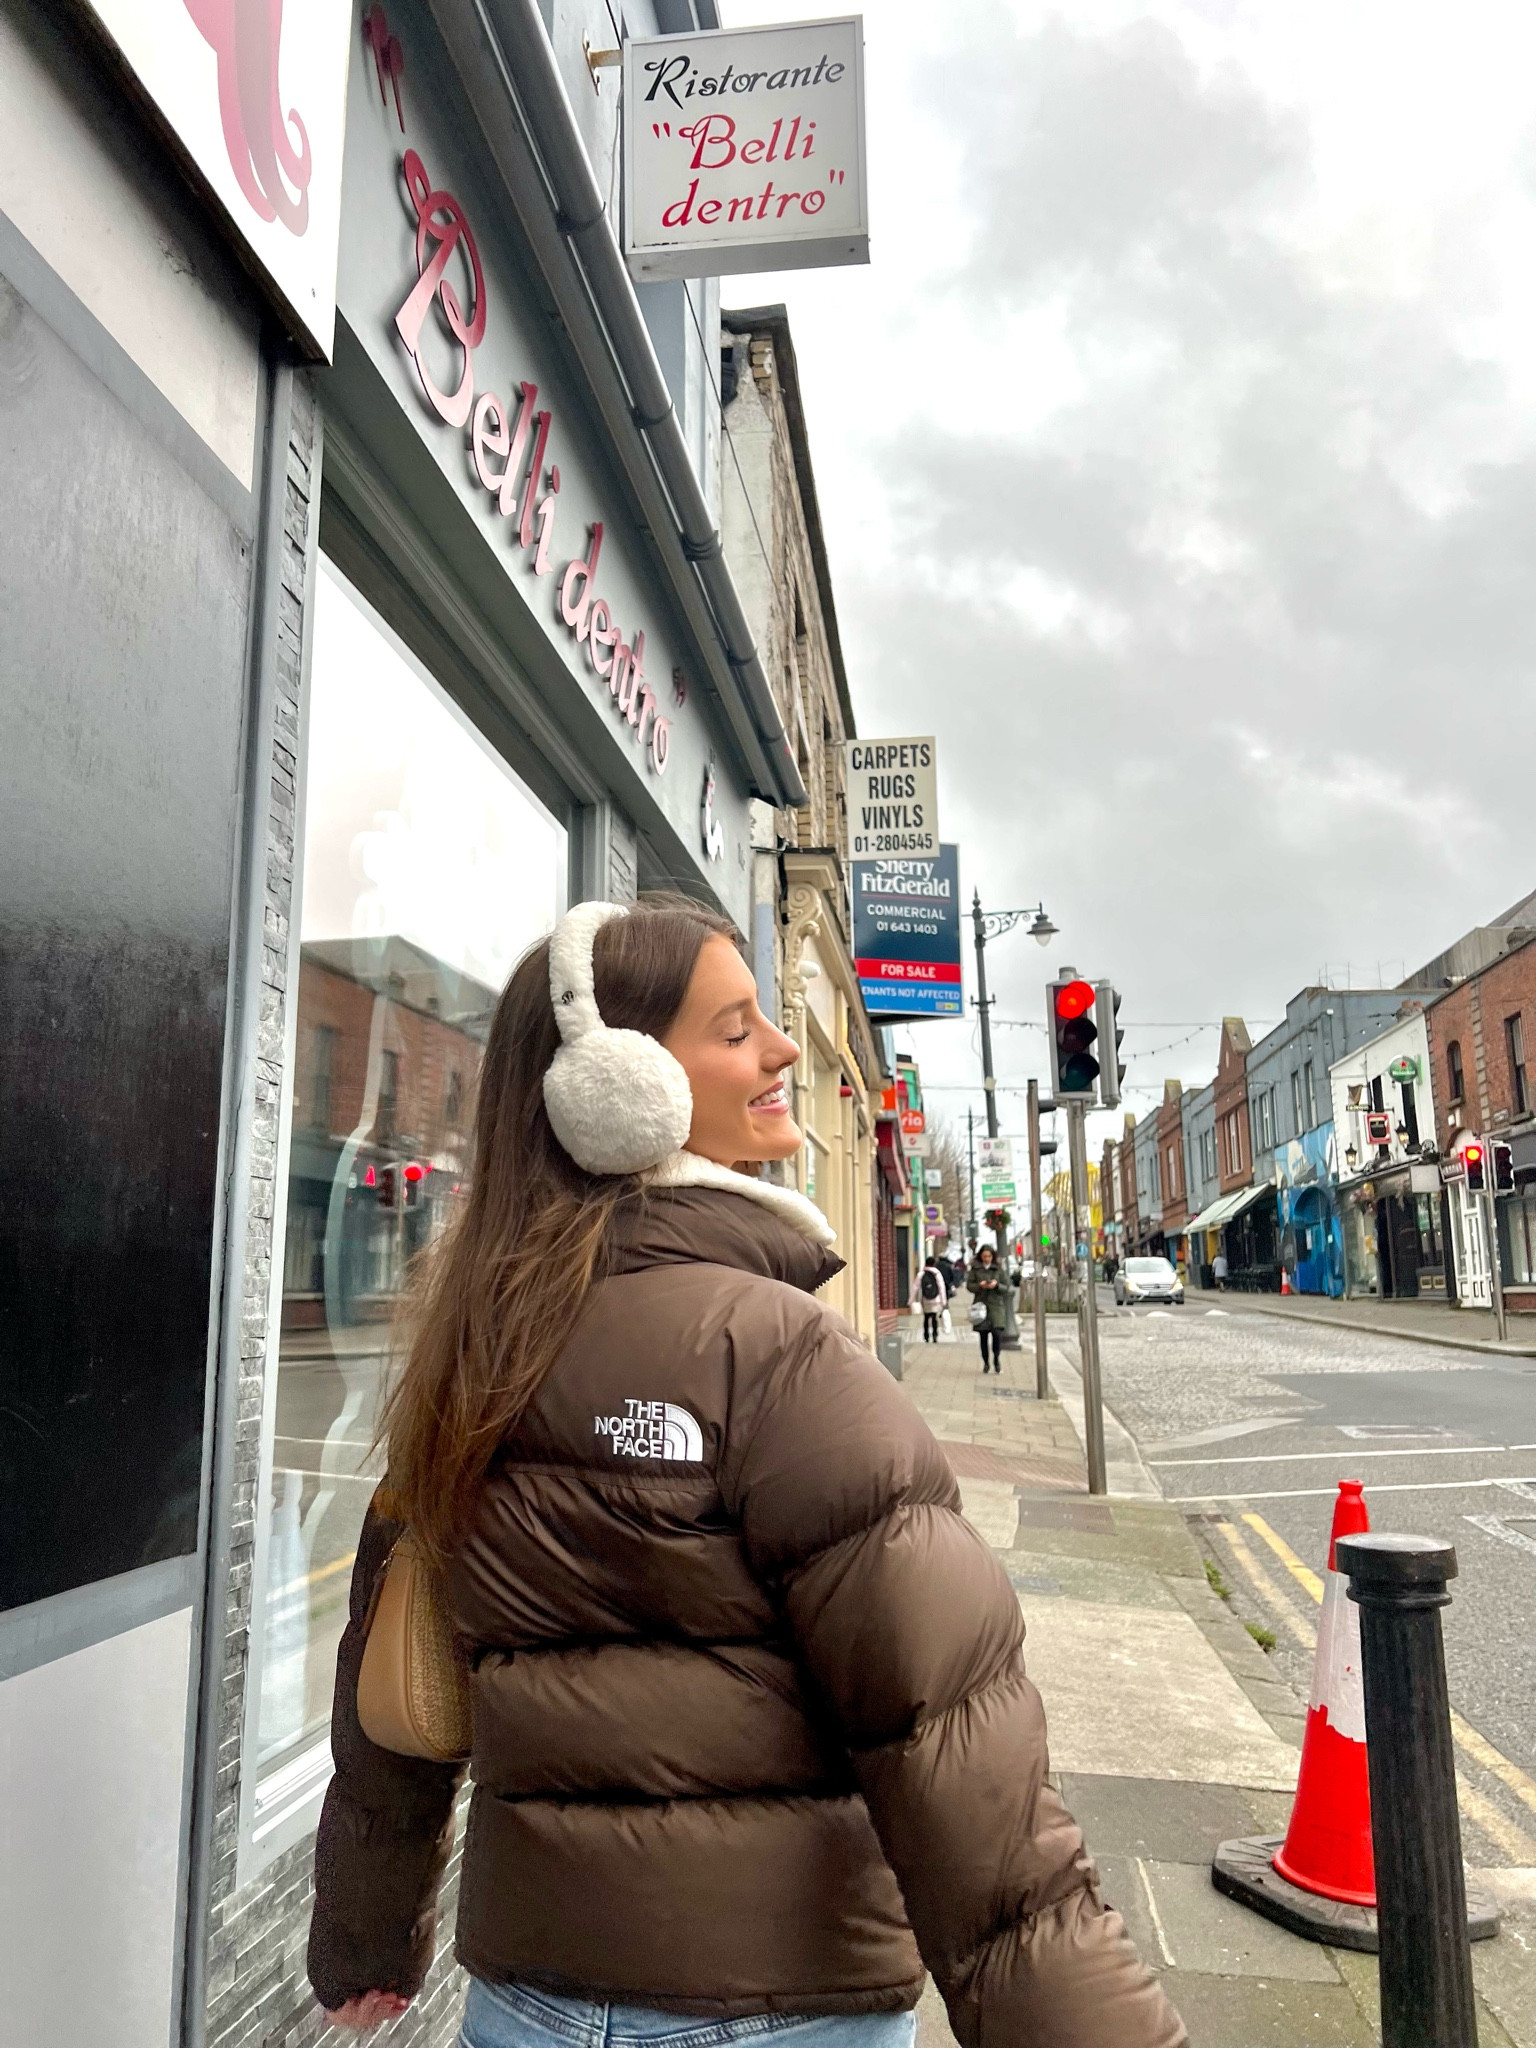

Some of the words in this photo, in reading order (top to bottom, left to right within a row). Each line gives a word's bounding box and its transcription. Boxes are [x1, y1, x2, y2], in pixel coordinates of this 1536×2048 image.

[644, 54, 845, 110] Ristorante
[652, 114, 817, 170] "Belli
[661, 169, 845, 228] dentro"
[852, 743, 931, 771] CARPETS
[868, 774, 916, 800] RUGS
[861, 804, 924, 830] VINYLS
[854, 833, 933, 853] 01-2804545
[861, 872, 950, 898] FitzGerald
[866, 903, 946, 920] COMMERCIAL
[876, 921, 889, 931] 01
[890, 922, 911, 933] 643
[913, 923, 938, 935] 1403
[881, 963, 905, 977] FOR
[906, 965, 936, 979] SALE
[862, 985, 897, 997] ENANTS
[898, 987, 915, 998] NOT
[917, 989, 960, 1000] AFFECTED
[624, 1398, 664, 1421] THE
[594, 1416, 664, 1440] NORTH
[613, 1436, 664, 1459] FACE
